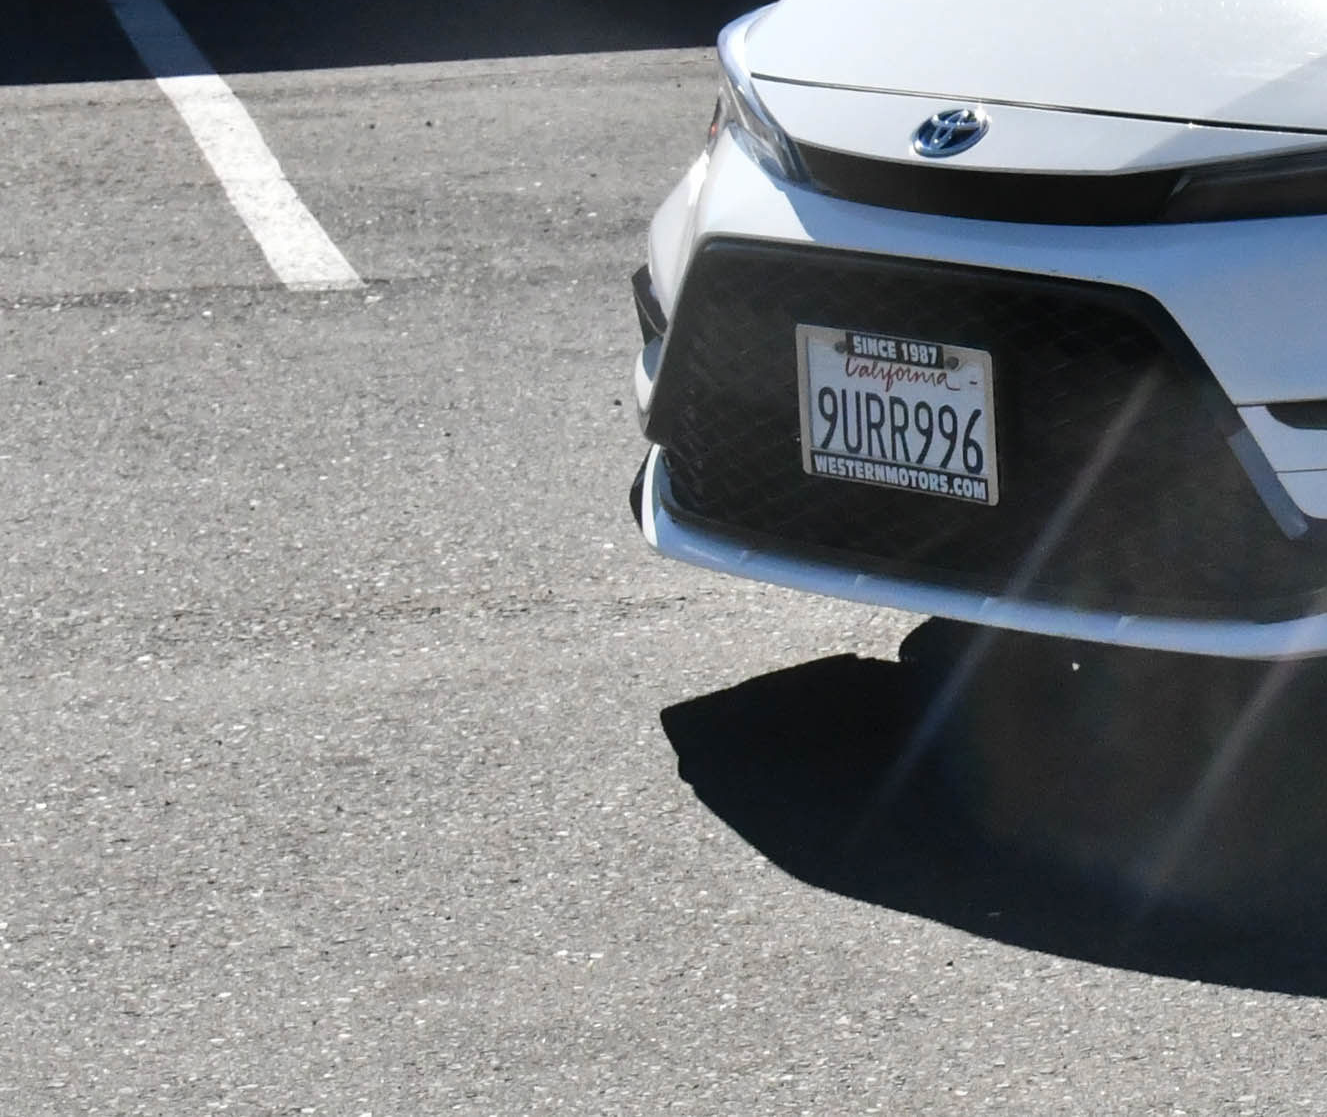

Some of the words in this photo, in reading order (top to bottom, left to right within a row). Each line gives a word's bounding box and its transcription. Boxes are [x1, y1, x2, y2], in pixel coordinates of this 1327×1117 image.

[852, 335, 897, 360] SINCE
[902, 342, 937, 365] 1987
[845, 355, 961, 393] California
[817, 386, 984, 475] 9URR996
[814, 454, 987, 500] WESTERNMOTORS.COM
